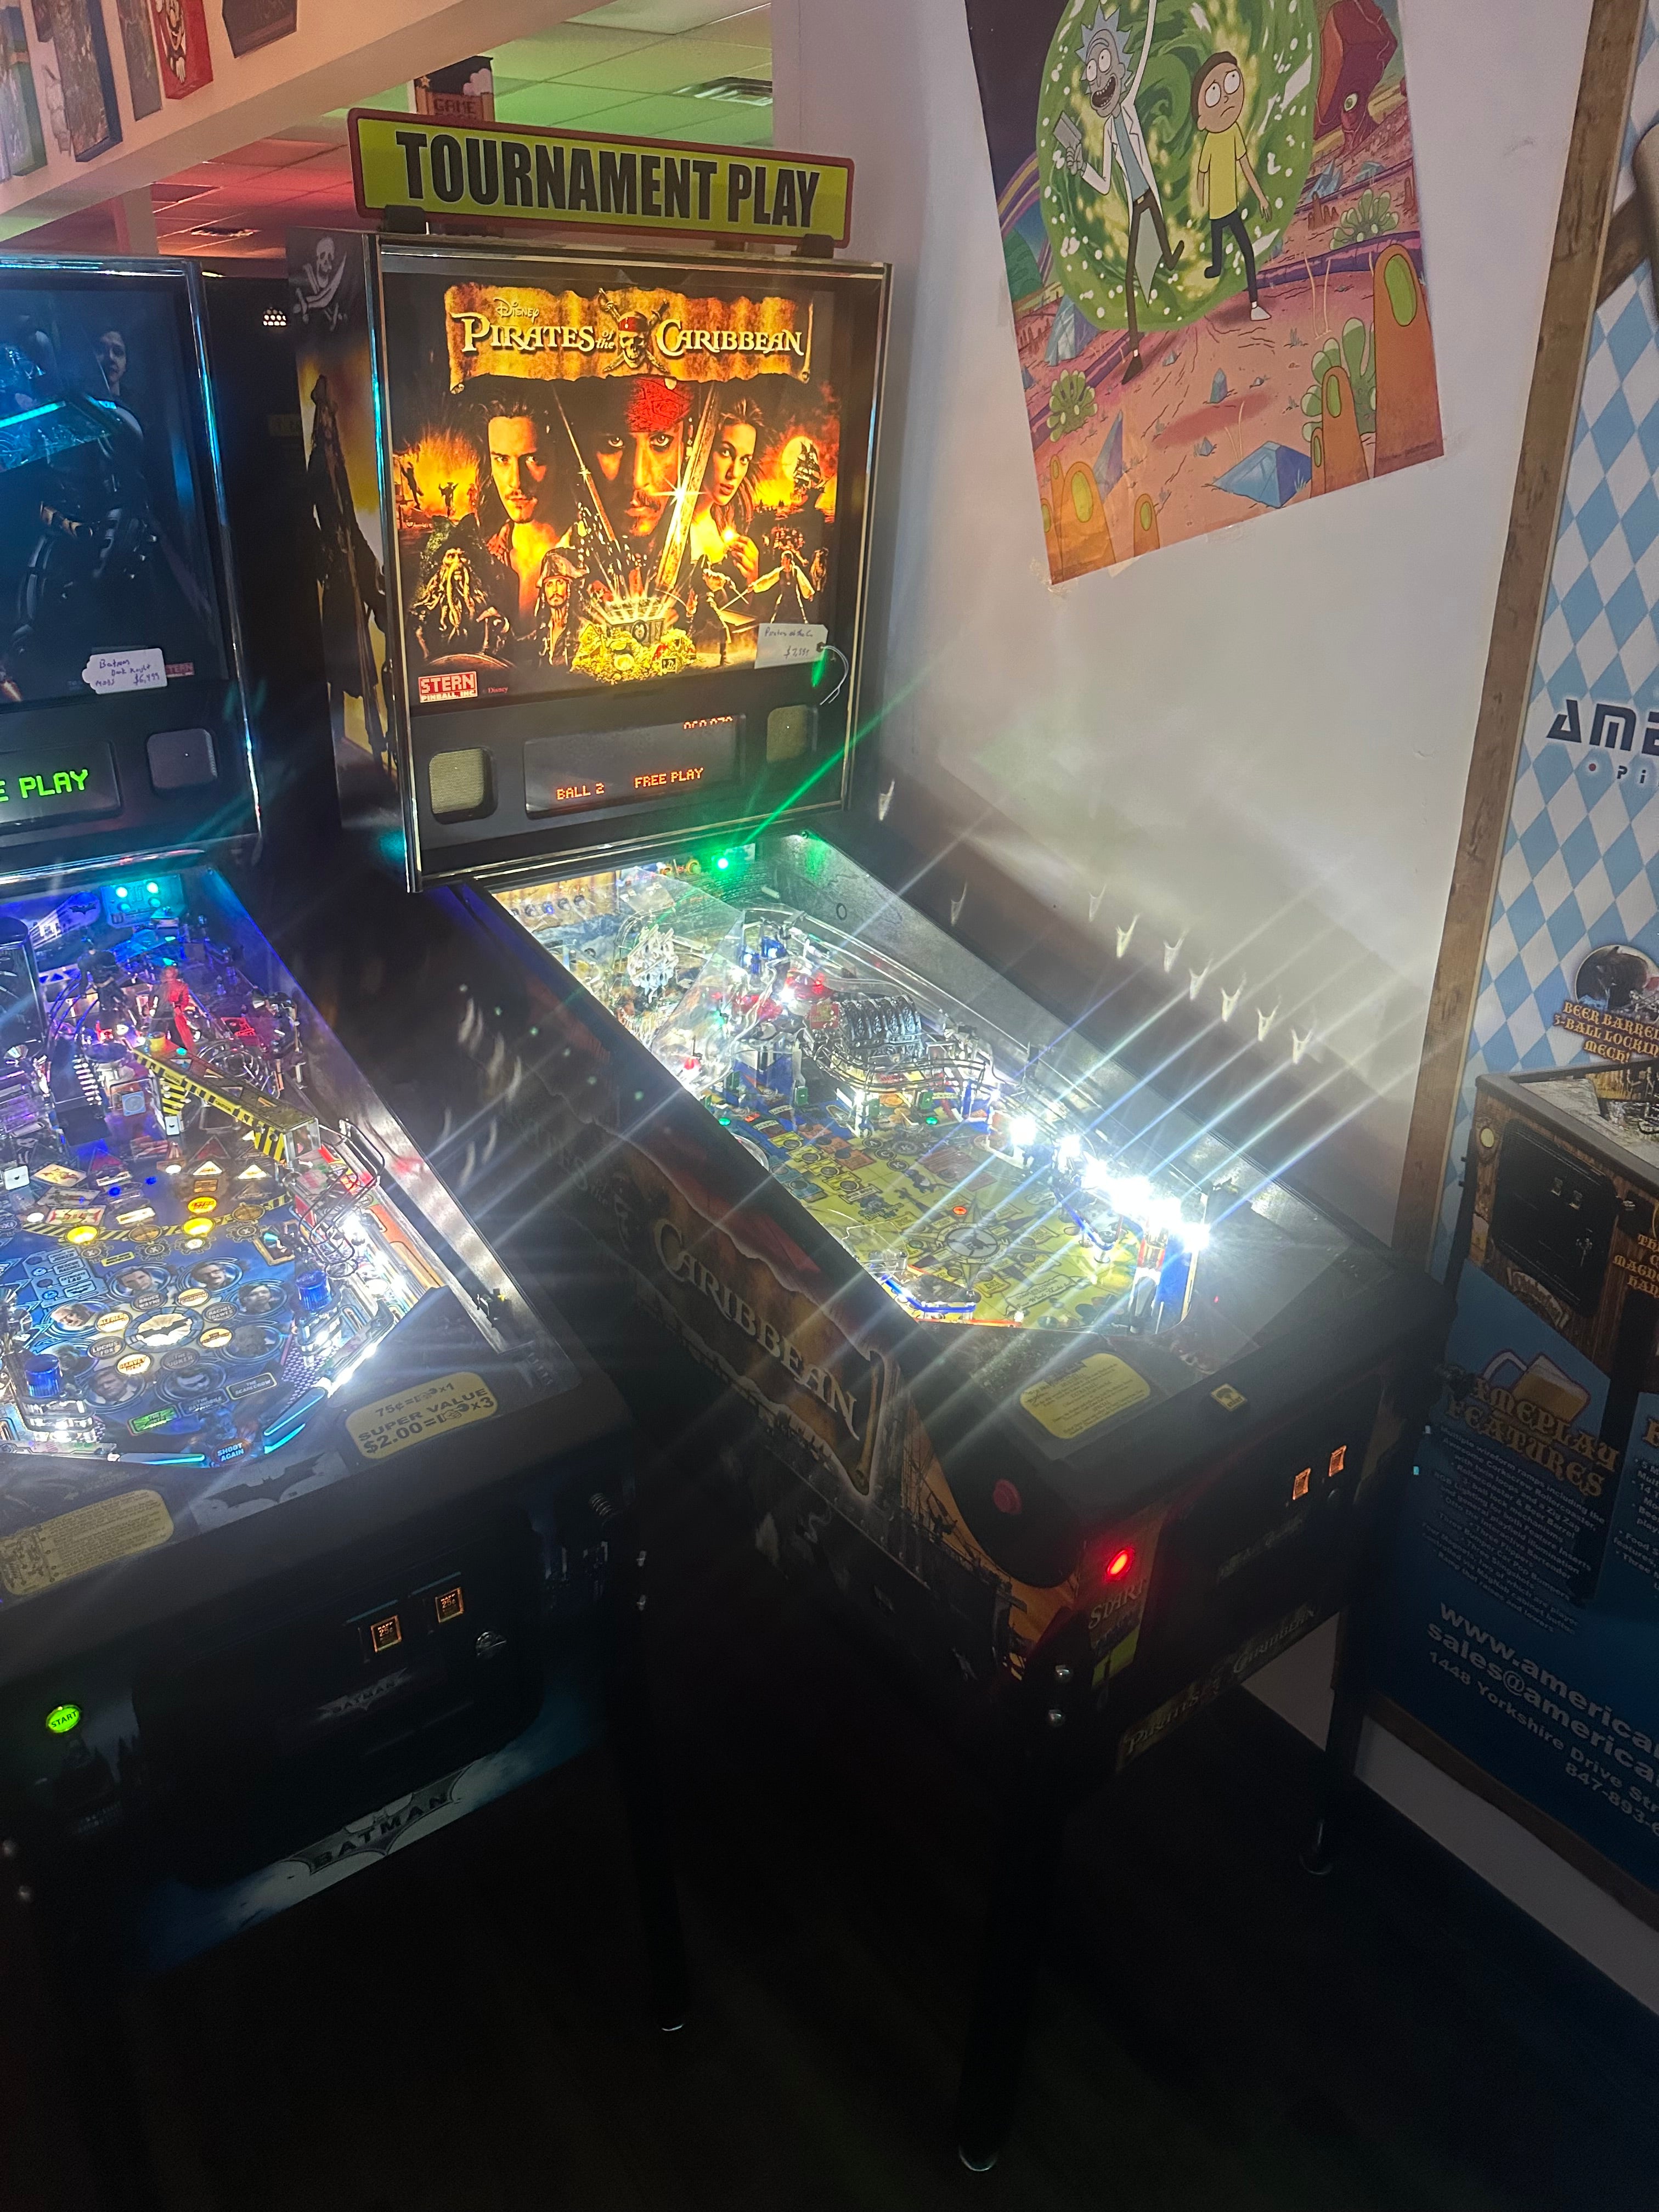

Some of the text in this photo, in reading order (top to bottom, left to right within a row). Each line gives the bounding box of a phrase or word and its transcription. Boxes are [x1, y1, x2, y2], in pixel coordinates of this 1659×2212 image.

[396, 131, 820, 228] TOURNAMENT PLAY
[451, 312, 806, 357] PIRATES of the CARIBBEAN
[166, 664, 193, 674] TERN
[421, 674, 475, 695] STERN
[19, 769, 89, 799] PLAY
[634, 767, 704, 789] FREE PLAY
[556, 782, 605, 800] BALL 2
[1563, 1001, 1600, 1025] BEER
[1554, 1014, 1601, 1040] 3-BALL
[138, 1294, 160, 1304] BRUCE
[138, 1298, 161, 1309] WAYNE
[208, 1305, 232, 1316] RACHEL
[210, 1309, 234, 1321] DAWES
[653, 1218, 860, 1442] CARIBBEAN
[92, 1340, 119, 1353] LUCIUS
[99, 1347, 115, 1356] FOX
[358, 1387, 488, 1442] SUPER VALUE
[1469, 1377, 1621, 1472] AMEPLAY
[217, 1442, 243, 1457] SHOOT
[220, 1449, 245, 1462] AGAIN
[1445, 1397, 1603, 1498] FEATURES
[1485, 1460, 1534, 1491] Corkscrew
[1544, 1485, 1589, 1515] including
[1588, 1509, 1606, 1524] the
[1088, 1578, 1149, 1630] START
[331, 1680, 396, 1714] BATMAN
[50, 1709, 78, 1728] START
[1429, 1651, 1471, 1686] 1448
[1477, 1680, 1565, 1751] Yorkshire
[1570, 1746, 1623, 1788] Drive
[314, 1792, 447, 1865] BATMAN
